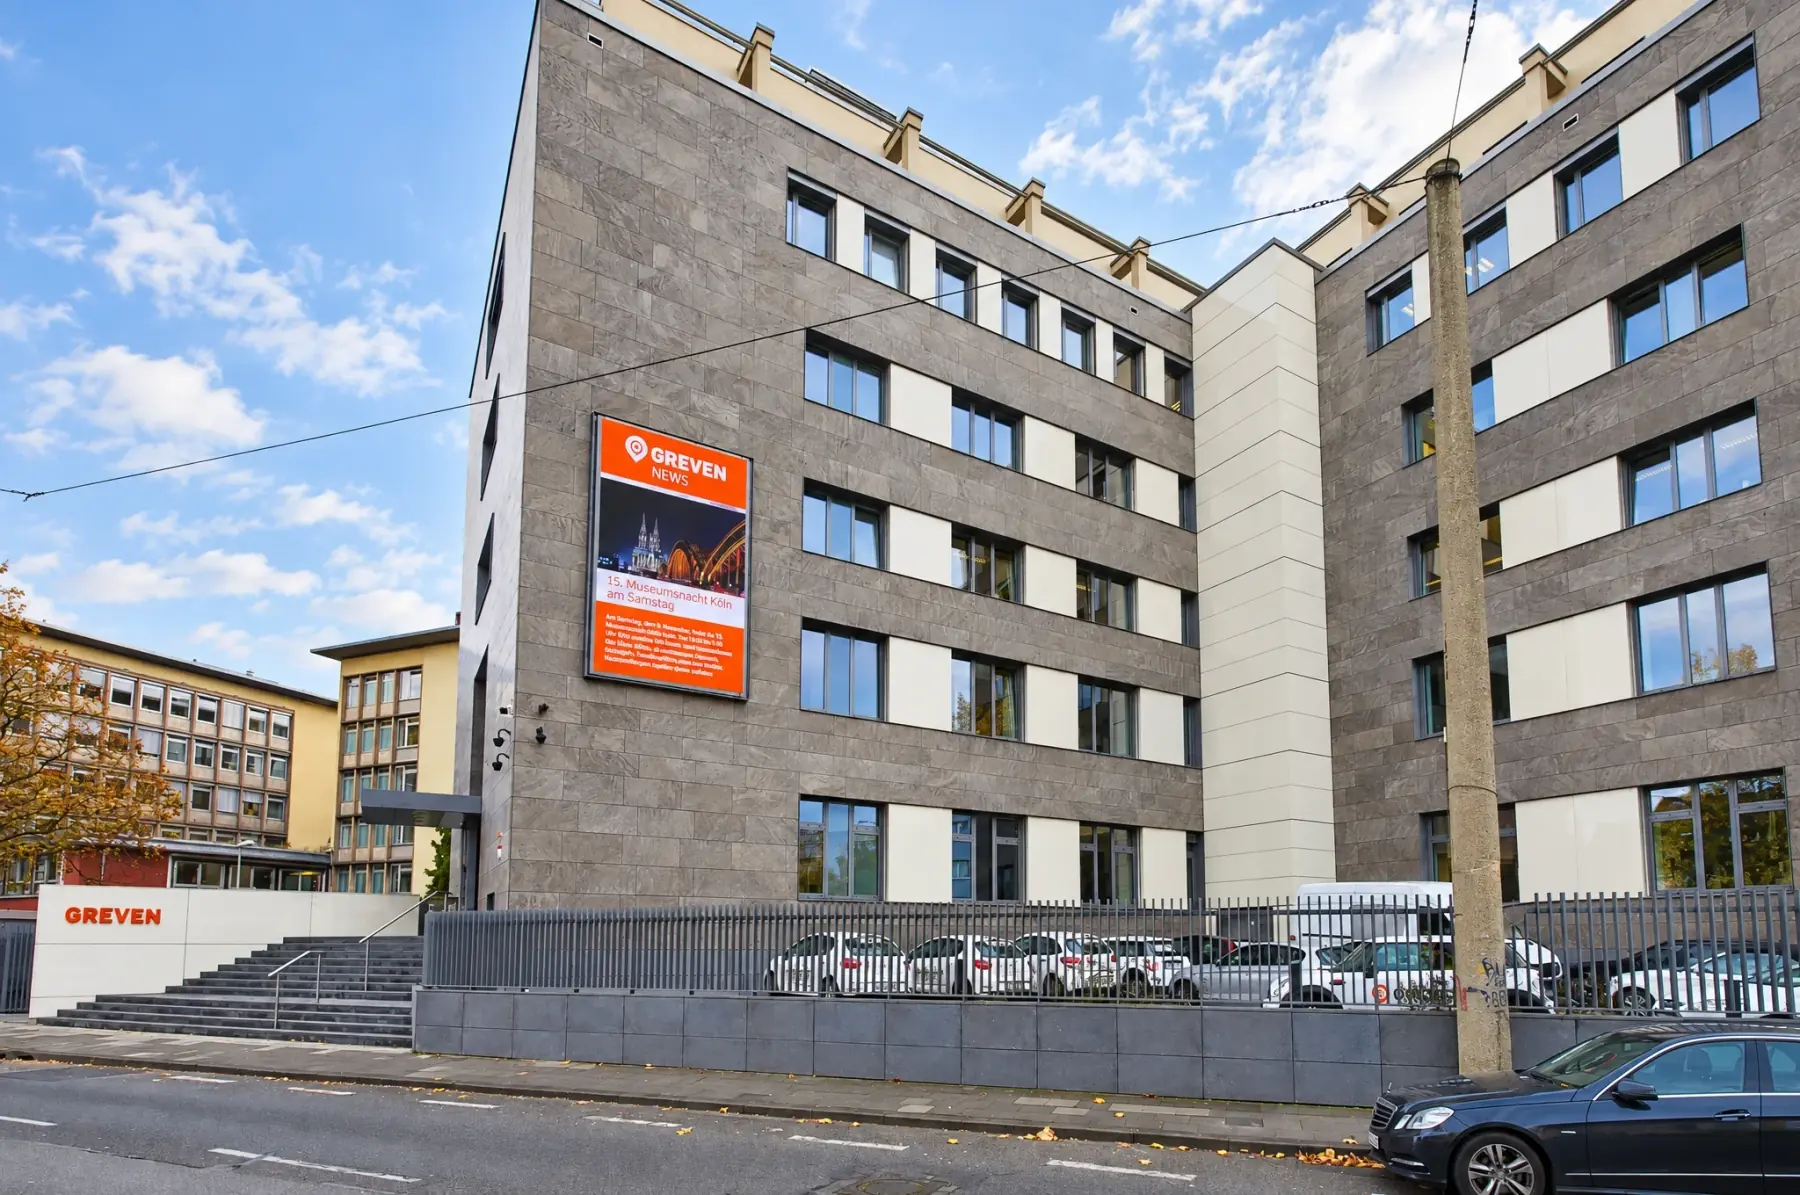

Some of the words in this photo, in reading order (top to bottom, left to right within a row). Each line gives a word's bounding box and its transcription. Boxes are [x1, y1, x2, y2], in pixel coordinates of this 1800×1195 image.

[651, 447, 727, 482] GREVEN
[651, 466, 689, 487] NEWS
[607, 575, 623, 588] 15.
[626, 579, 708, 605] Museumsnacht
[710, 597, 733, 610] Köln
[607, 590, 625, 601] am
[627, 592, 675, 612] Samstag
[65, 906, 161, 925] GREVEN
